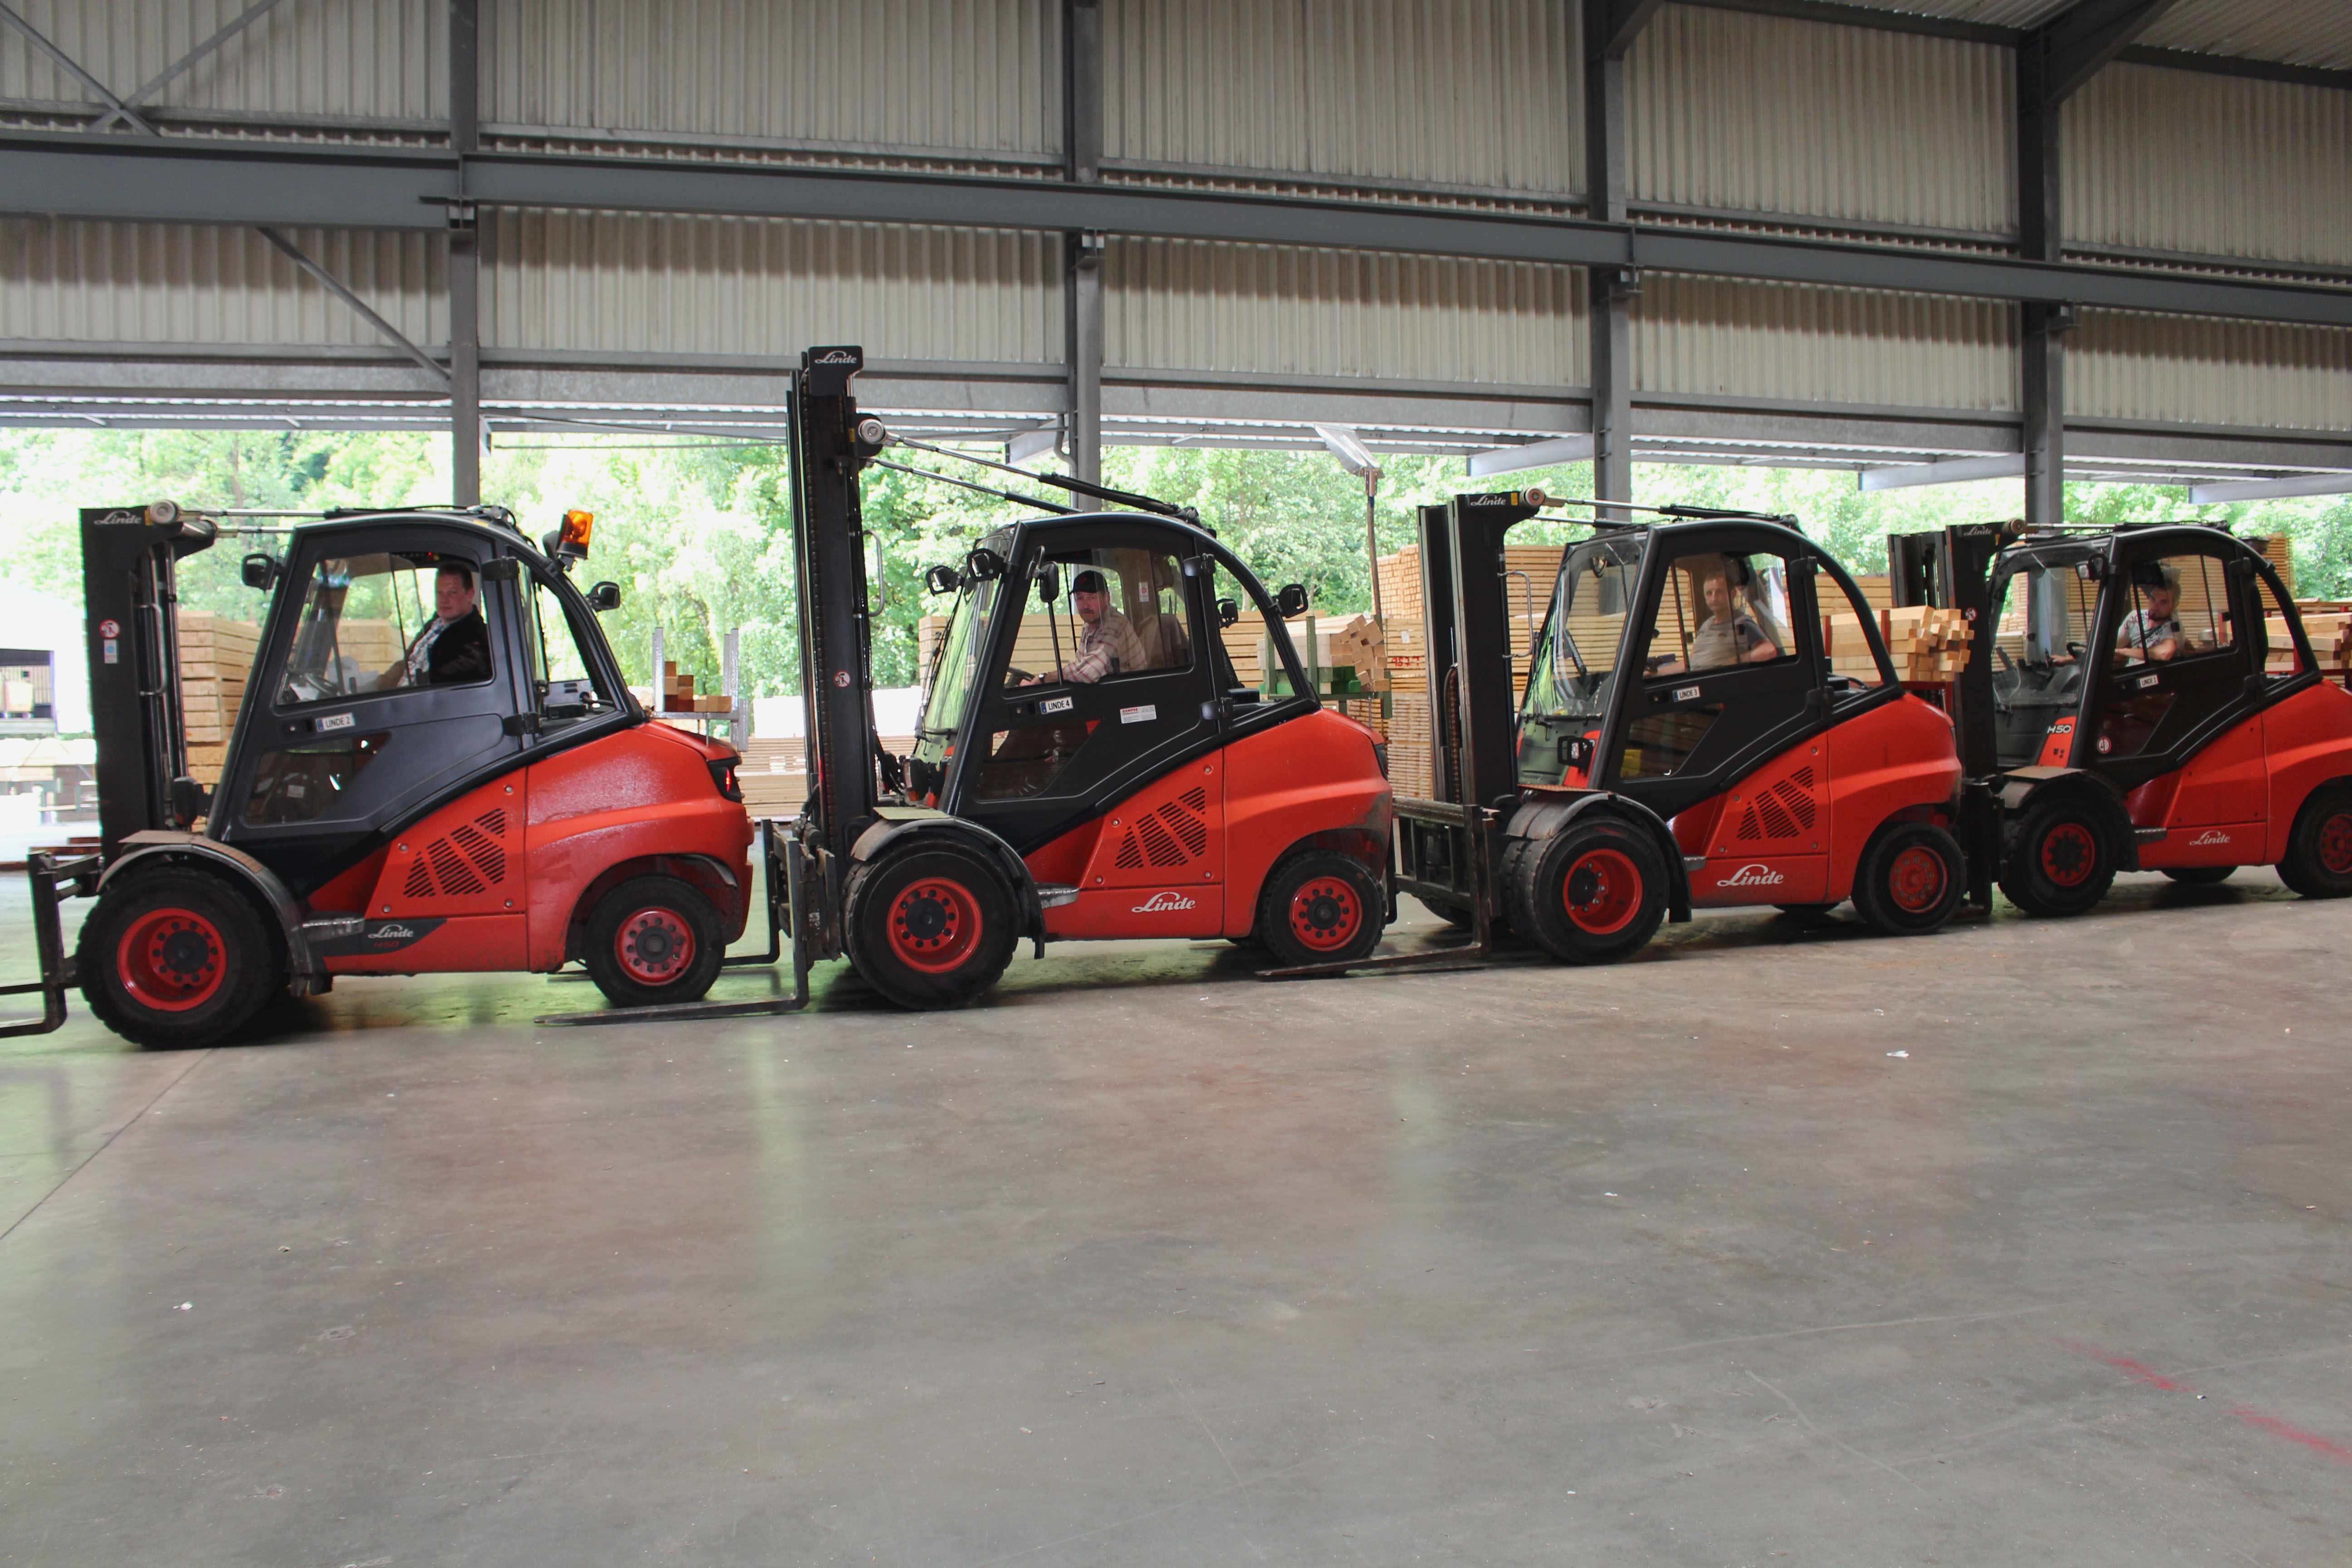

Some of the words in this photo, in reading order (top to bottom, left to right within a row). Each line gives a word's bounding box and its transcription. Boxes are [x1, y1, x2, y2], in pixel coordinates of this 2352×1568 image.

[814, 351, 857, 364] Linde
[1470, 494, 1506, 506] Linde
[94, 510, 141, 524] Linde
[1964, 525, 1992, 535] Linde
[1680, 689, 1694, 698] LINDE
[1048, 700, 1065, 710] LINDE
[325, 717, 344, 727] LINDE
[2047, 725, 2071, 734] H50
[2190, 830, 2230, 845] Linde
[1717, 864, 1784, 887] Linde
[1131, 892, 1195, 913] Linde
[368, 924, 414, 938] Linde
